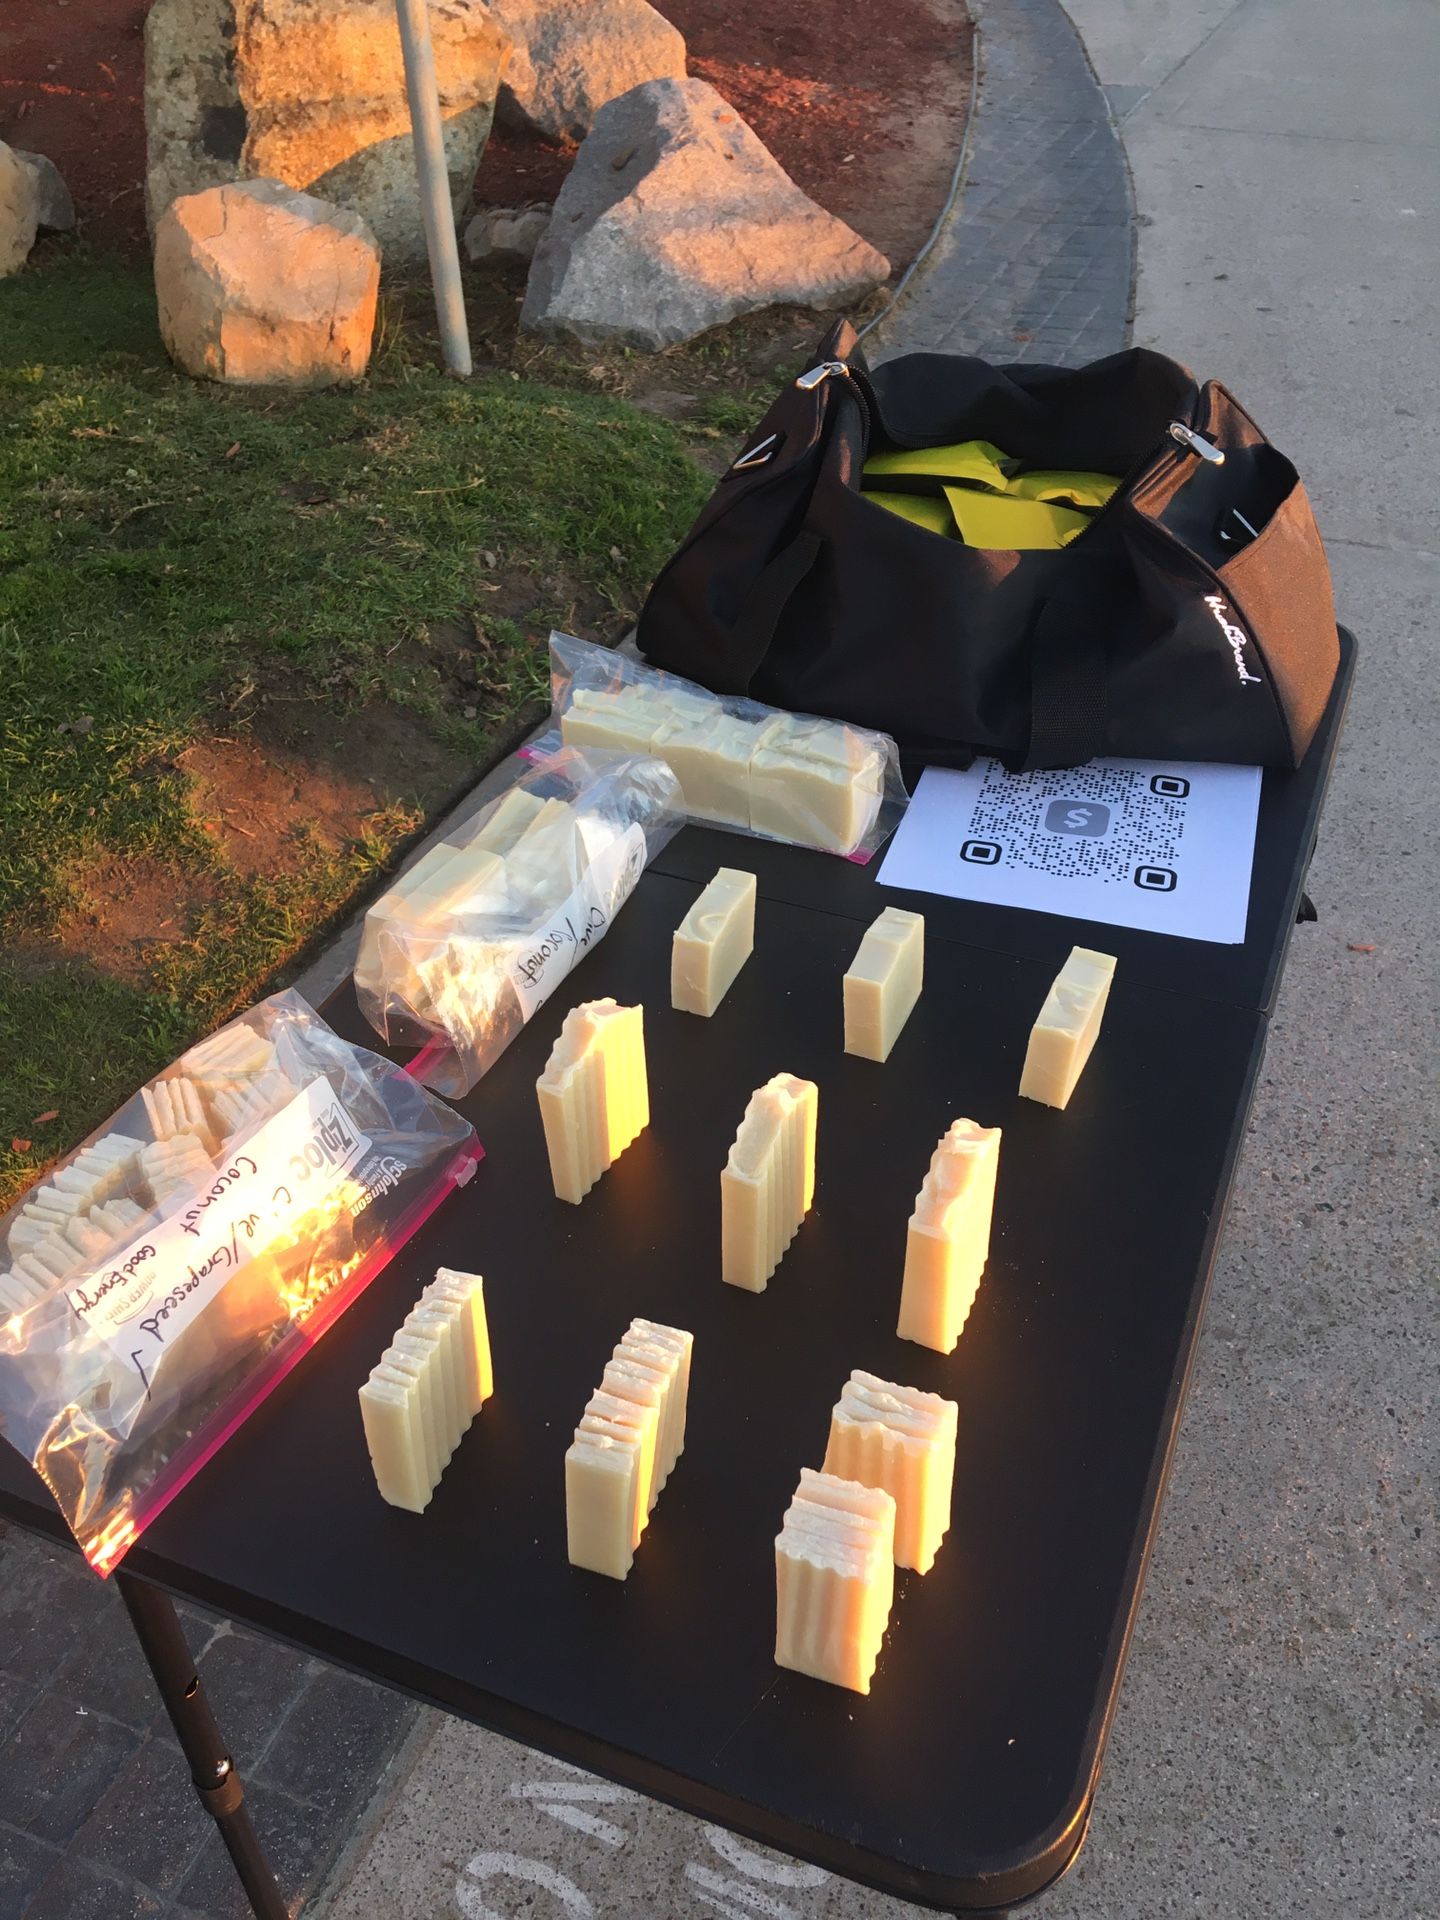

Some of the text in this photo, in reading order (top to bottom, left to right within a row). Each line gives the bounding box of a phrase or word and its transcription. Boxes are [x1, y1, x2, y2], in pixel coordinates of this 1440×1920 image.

[289, 1115, 353, 1181] Ziploc
[179, 1156, 257, 1236] Coconut
[63, 1245, 156, 1320] Good Energy
